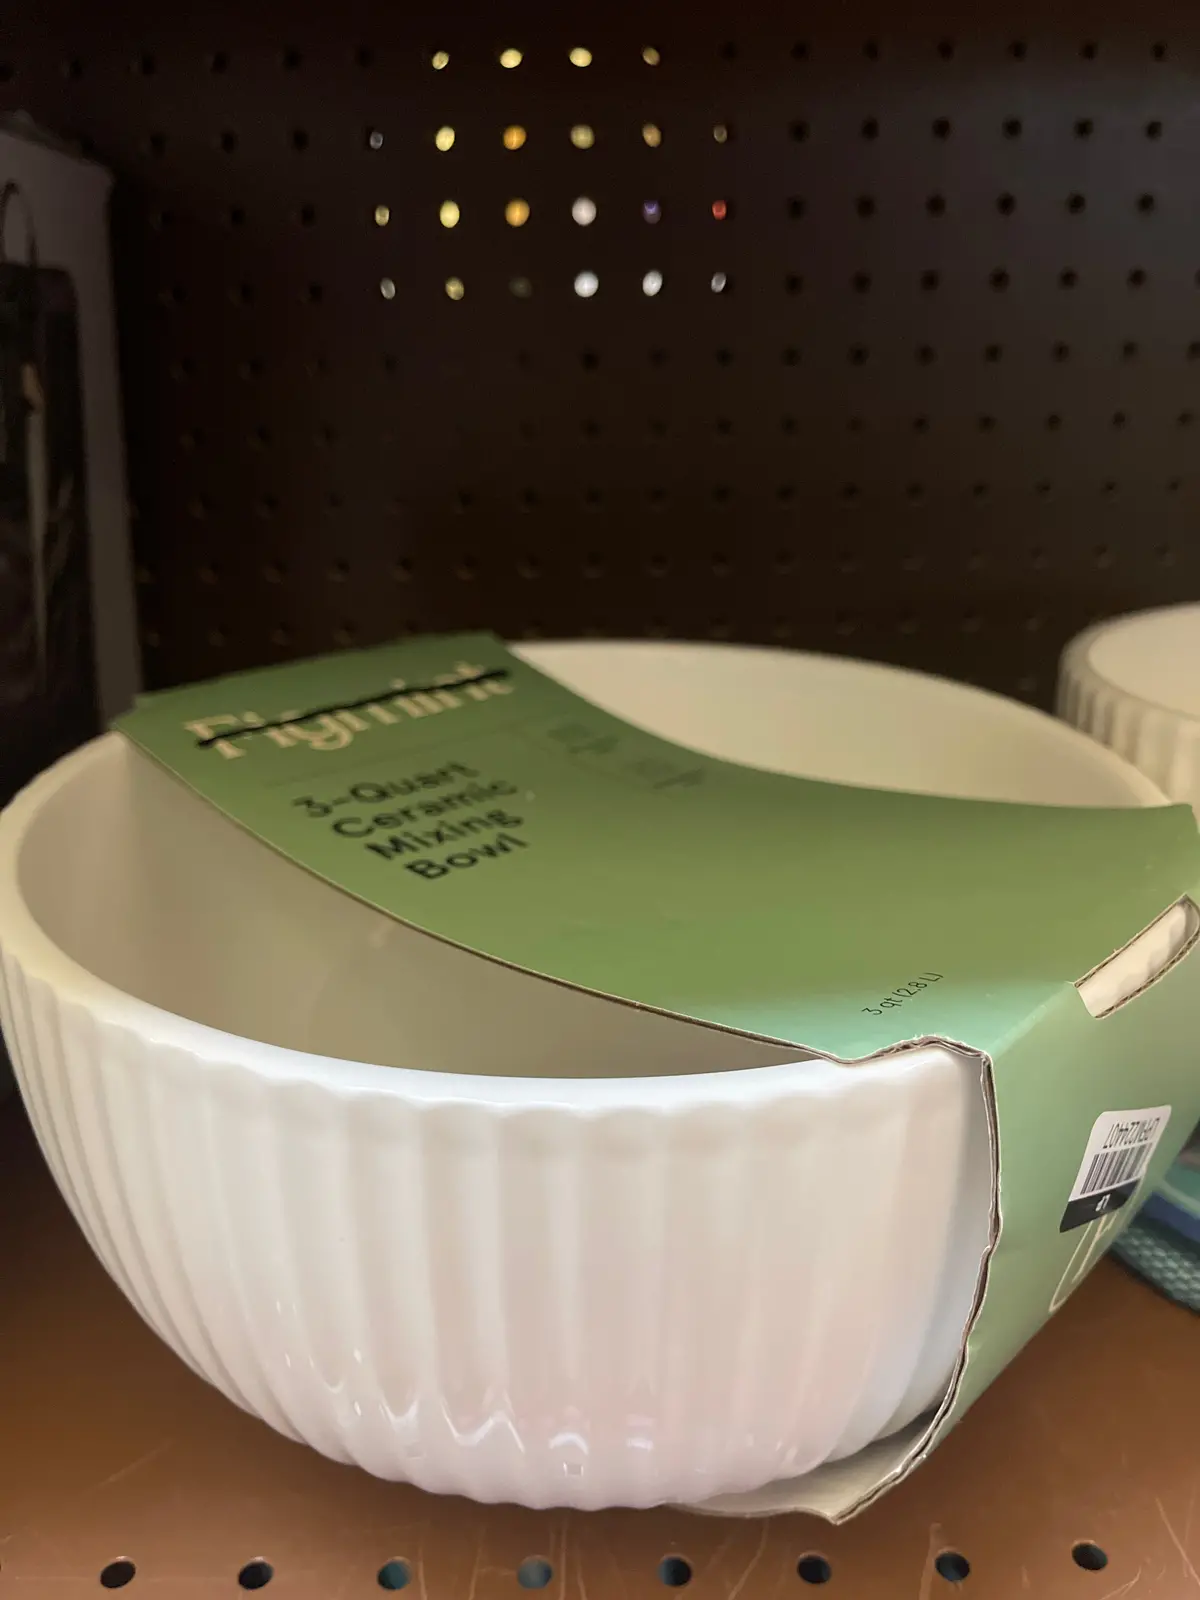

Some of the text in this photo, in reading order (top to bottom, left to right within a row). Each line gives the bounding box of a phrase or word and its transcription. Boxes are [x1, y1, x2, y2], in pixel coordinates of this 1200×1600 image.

[292, 761, 480, 818] 3-Quart
[332, 780, 518, 838] Ceramic
[364, 809, 524, 860] Mixing
[403, 832, 530, 880] Bowl
[861, 1007, 882, 1016] 3
[880, 997, 903, 1008] qt
